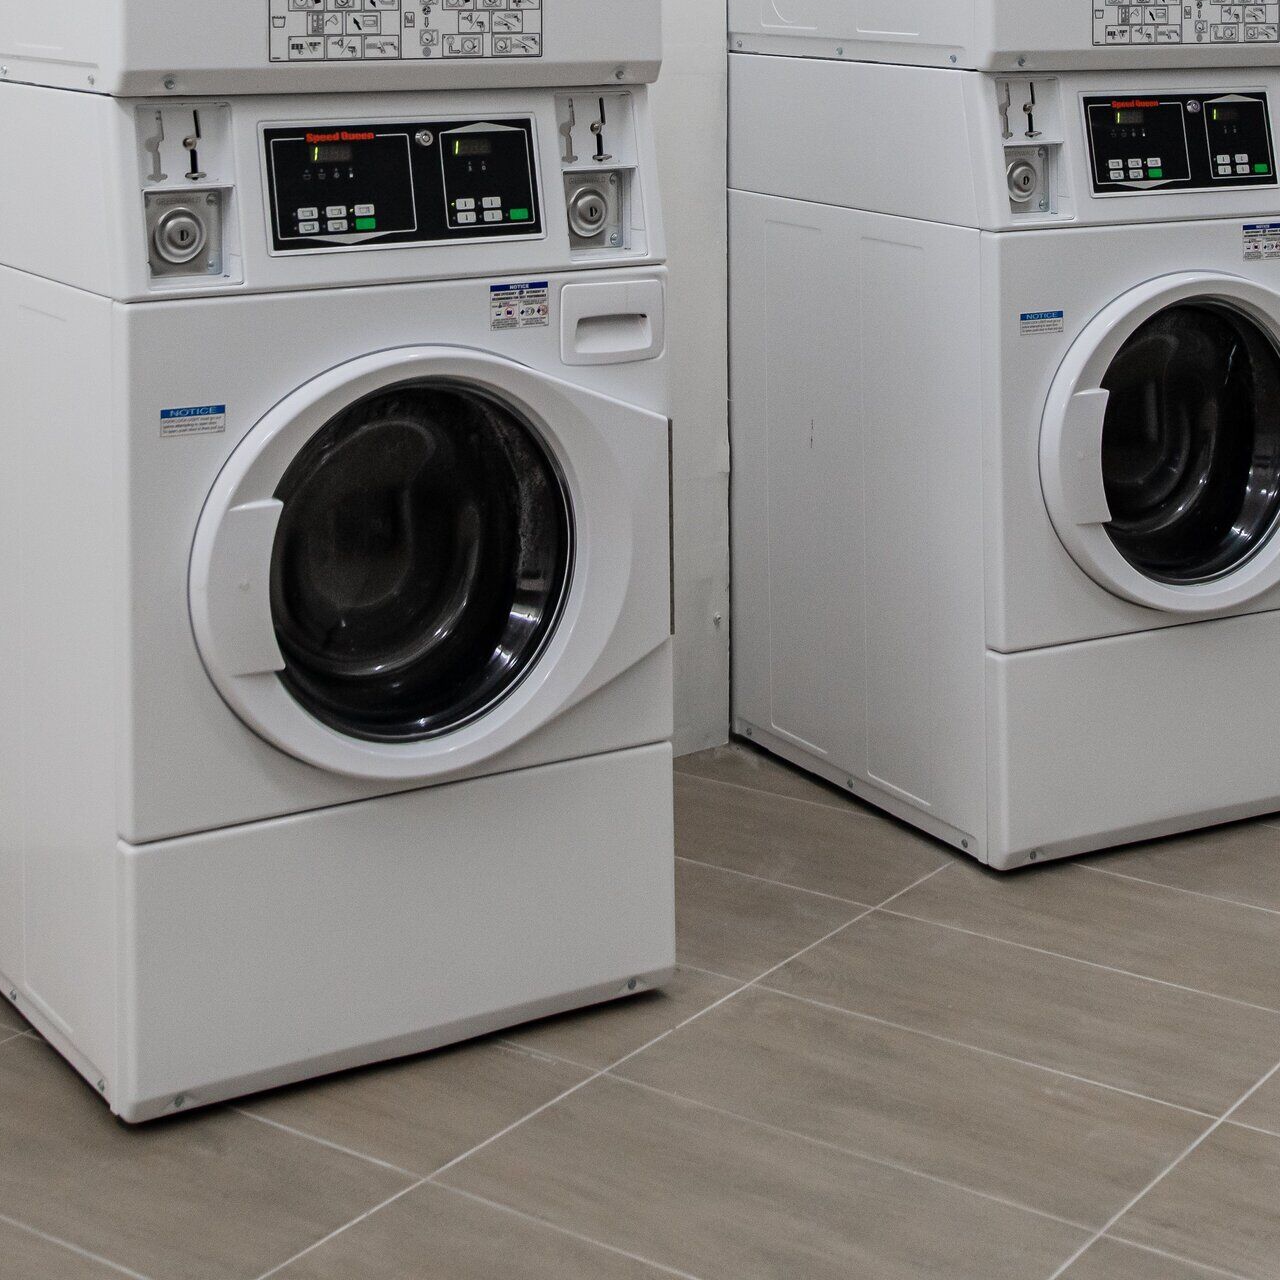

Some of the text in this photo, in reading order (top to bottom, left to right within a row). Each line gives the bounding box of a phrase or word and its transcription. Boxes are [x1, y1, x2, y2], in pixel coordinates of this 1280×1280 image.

[306, 131, 374, 144] Speed Queen
[170, 407, 216, 416] NOTICE
